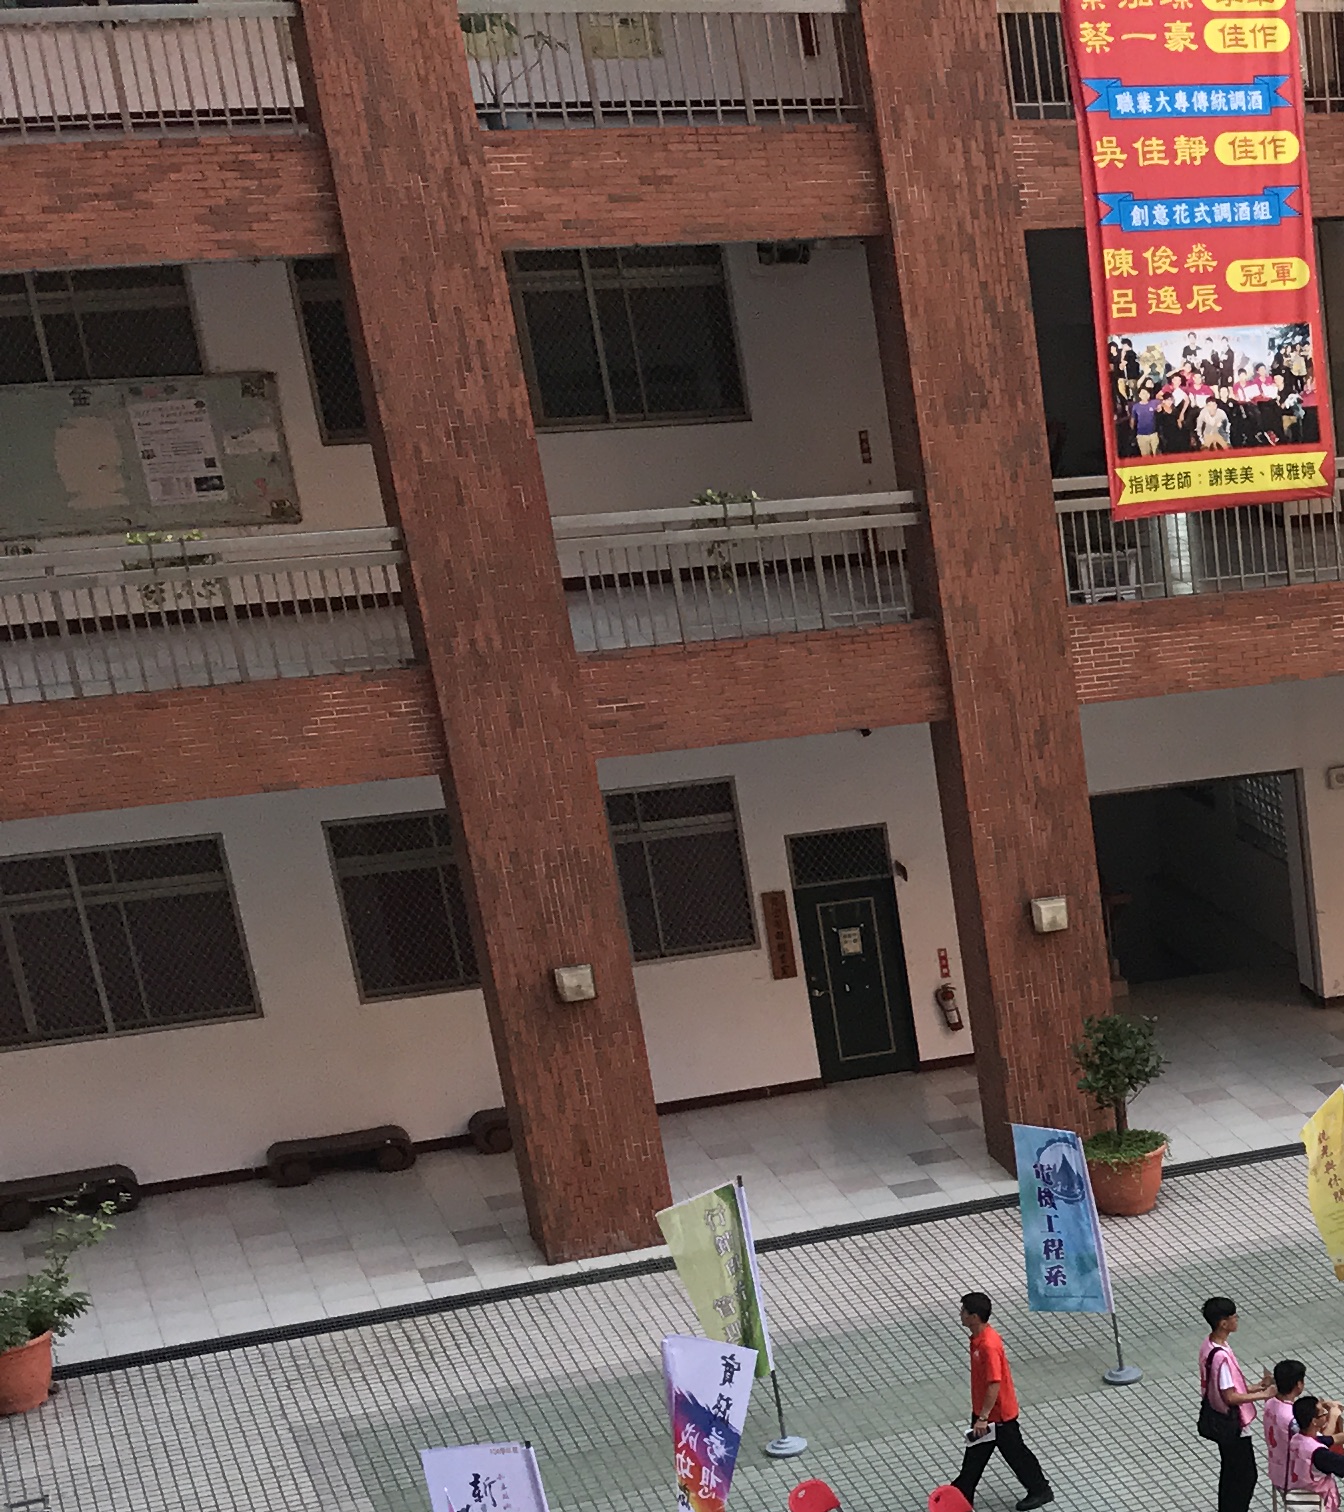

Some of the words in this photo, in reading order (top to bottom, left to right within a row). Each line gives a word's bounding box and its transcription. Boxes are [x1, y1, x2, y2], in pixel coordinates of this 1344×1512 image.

[1079, 20, 1199, 54] 蔡一豪
[1218, 23, 1277, 49] 佳作
[1115, 90, 1263, 115] 職業大專傳統調酒
[1093, 135, 1210, 168] 吳佳靜
[1228, 135, 1287, 161] 佳作
[1130, 201, 1273, 227] 創意花式調酒組
[1240, 261, 1297, 287] 冠軍
[1111, 284, 1222, 318] 呂逸辰
[1034, 1163, 1067, 1287] 電機工程系
